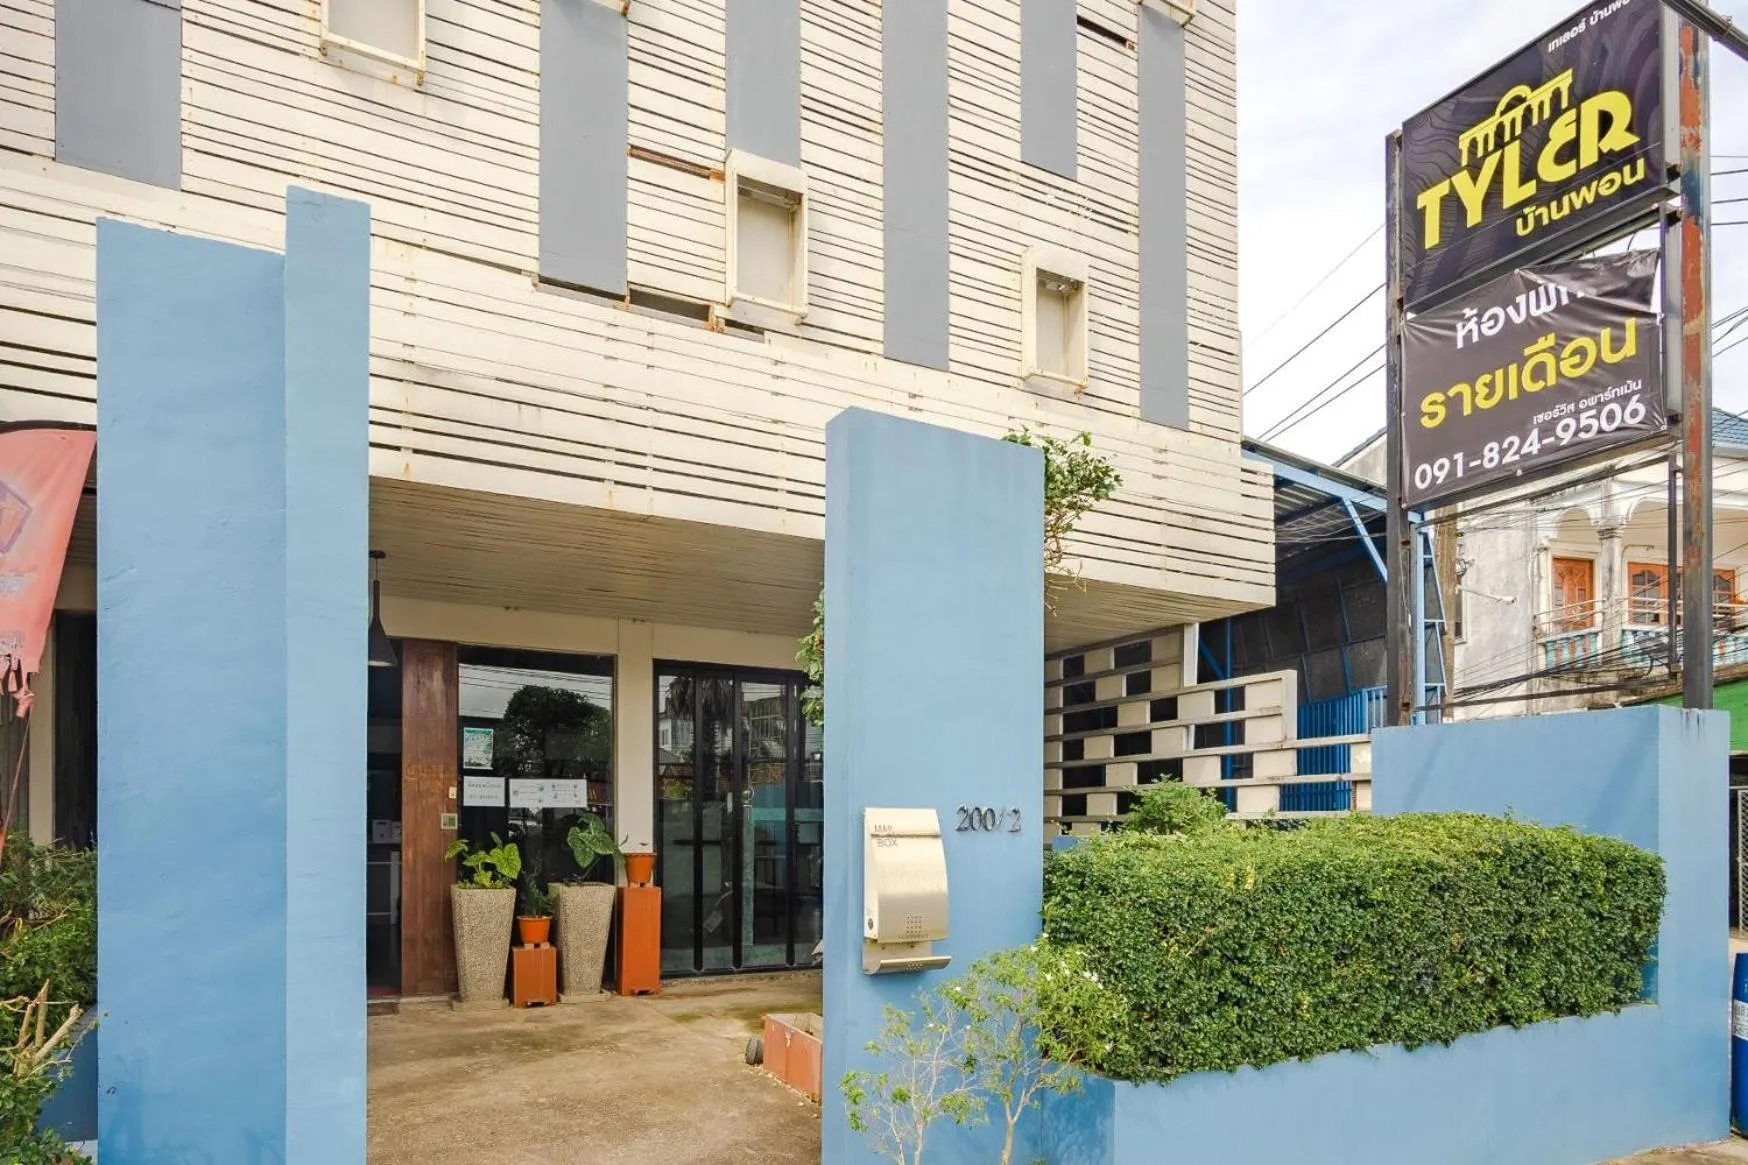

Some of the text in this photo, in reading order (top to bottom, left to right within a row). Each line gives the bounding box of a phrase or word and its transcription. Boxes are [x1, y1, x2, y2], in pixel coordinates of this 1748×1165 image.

[1417, 90, 1641, 250] TYLER
[1515, 157, 1646, 238] บ้านพอน
[1419, 316, 1639, 430] รายเดือน
[1414, 394, 1647, 491] 091-824-9506
[876, 837, 898, 848] BOX
[955, 803, 1022, 833] 200/2
